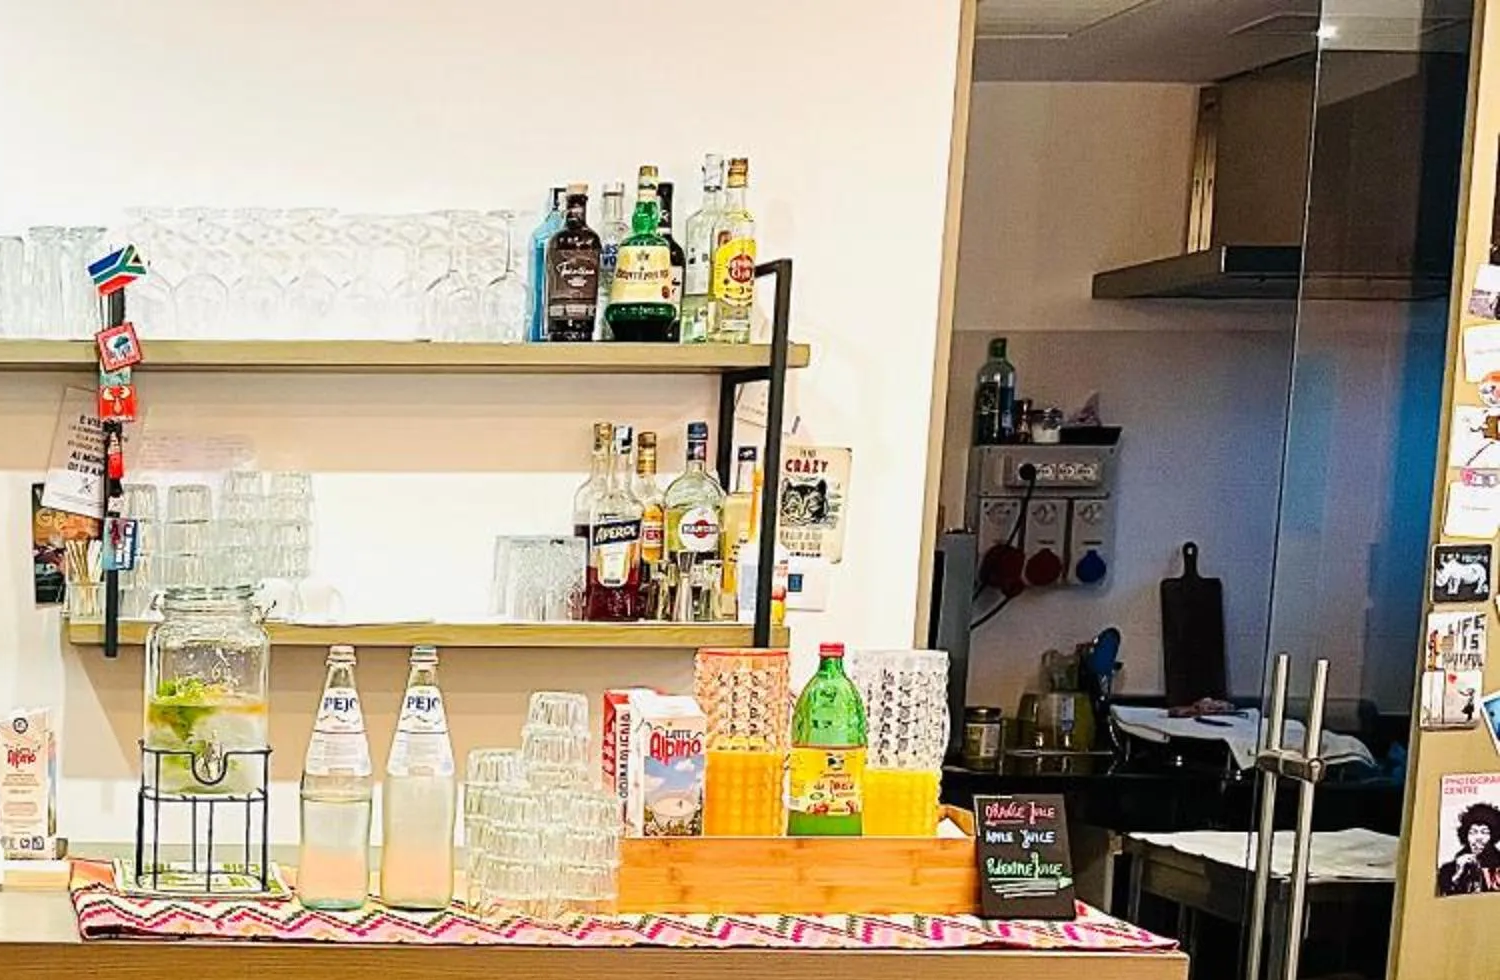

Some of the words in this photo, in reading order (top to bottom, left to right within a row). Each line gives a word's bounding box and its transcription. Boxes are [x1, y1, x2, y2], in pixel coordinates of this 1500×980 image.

[785, 458, 829, 473] CRAZY
[595, 524, 637, 543] APEROL
[1448, 613, 1487, 635] LIFE
[1462, 633, 1479, 649] IS
[650, 732, 701, 766] Alpino
